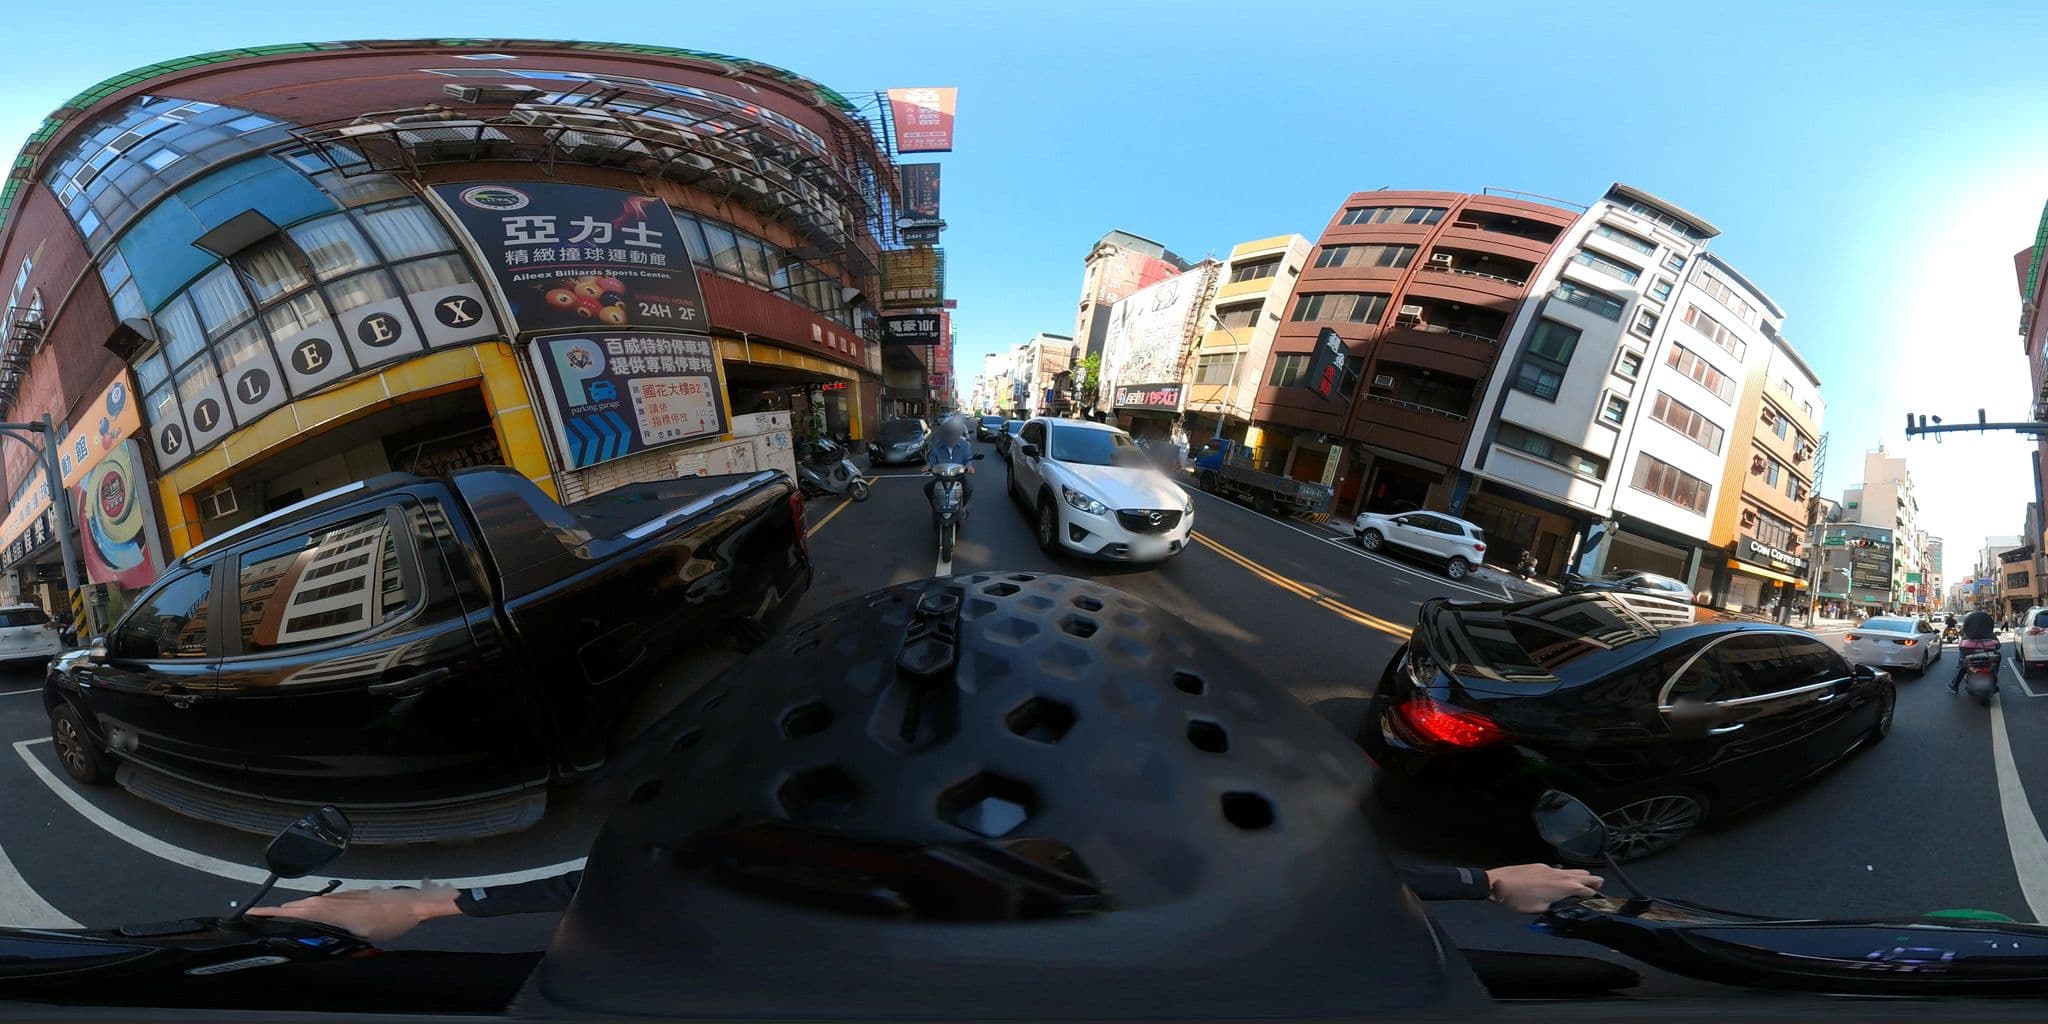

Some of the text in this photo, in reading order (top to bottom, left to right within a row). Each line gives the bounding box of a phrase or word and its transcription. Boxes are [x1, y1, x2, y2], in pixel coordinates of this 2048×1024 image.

[501, 215, 663, 249] 亞力士
[504, 247, 666, 266] 精緻撞球運動館
[512, 270, 551, 282] Aileex
[555, 268, 603, 277] Billiards
[605, 269, 638, 279] Sports
[638, 302, 696, 321] 24H 2F
[604, 337, 712, 356] 百威特約停車場
[610, 356, 713, 375] 提供專屬停車格
[642, 383, 701, 399] 國花大樓B2
[571, 402, 621, 416] parking garage
[649, 402, 669, 416] 請依
[652, 413, 689, 428] 指標停放
